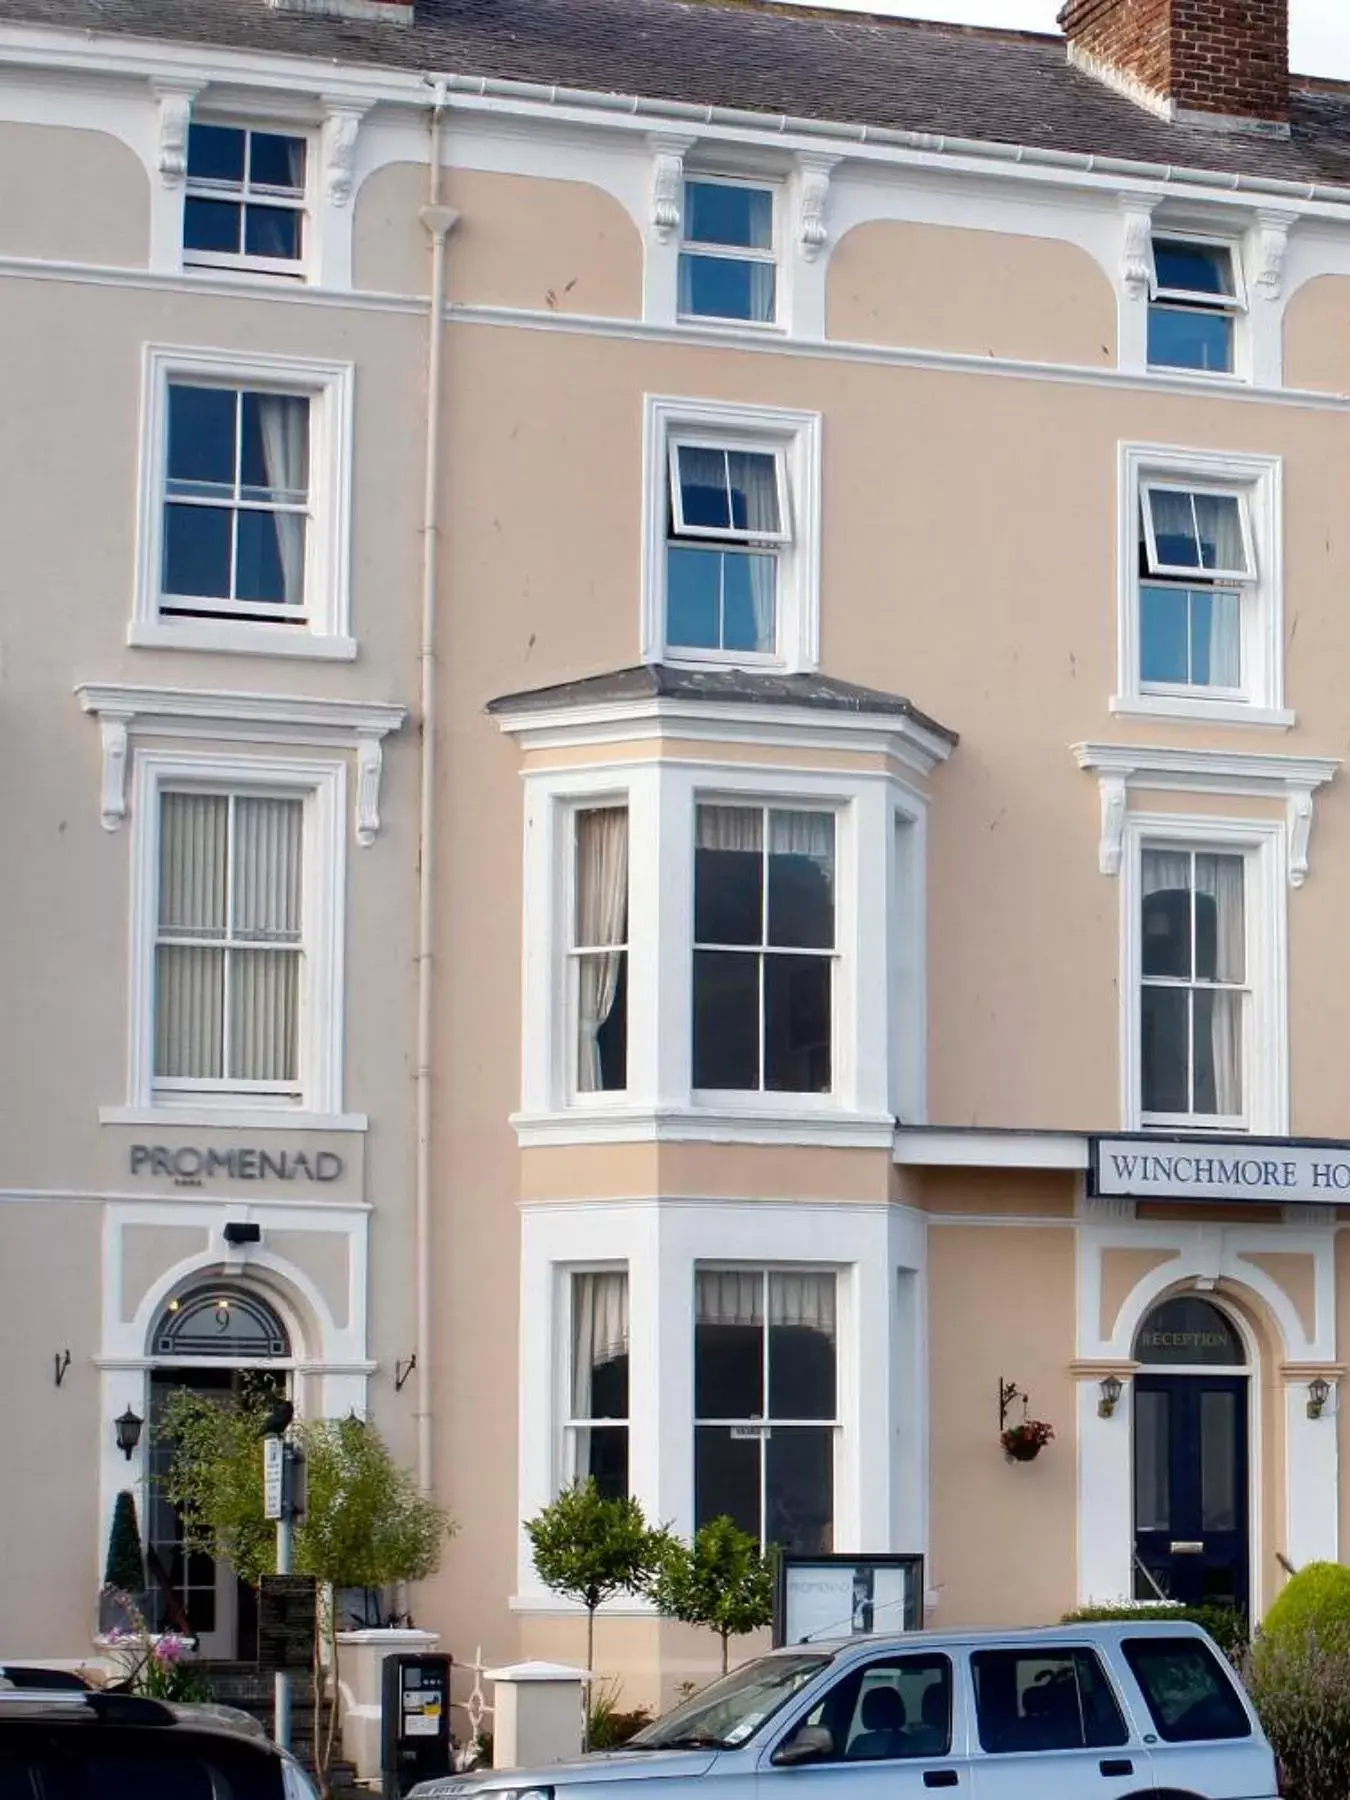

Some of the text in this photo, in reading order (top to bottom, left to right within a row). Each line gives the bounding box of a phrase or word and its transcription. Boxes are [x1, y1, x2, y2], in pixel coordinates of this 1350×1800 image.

[129, 1144, 343, 1182] PROMENAD
[1111, 1154, 1297, 1188] WINCHMORE
[214, 1308, 230, 1334] 9
[1141, 1330, 1229, 1348] RECEPTION
